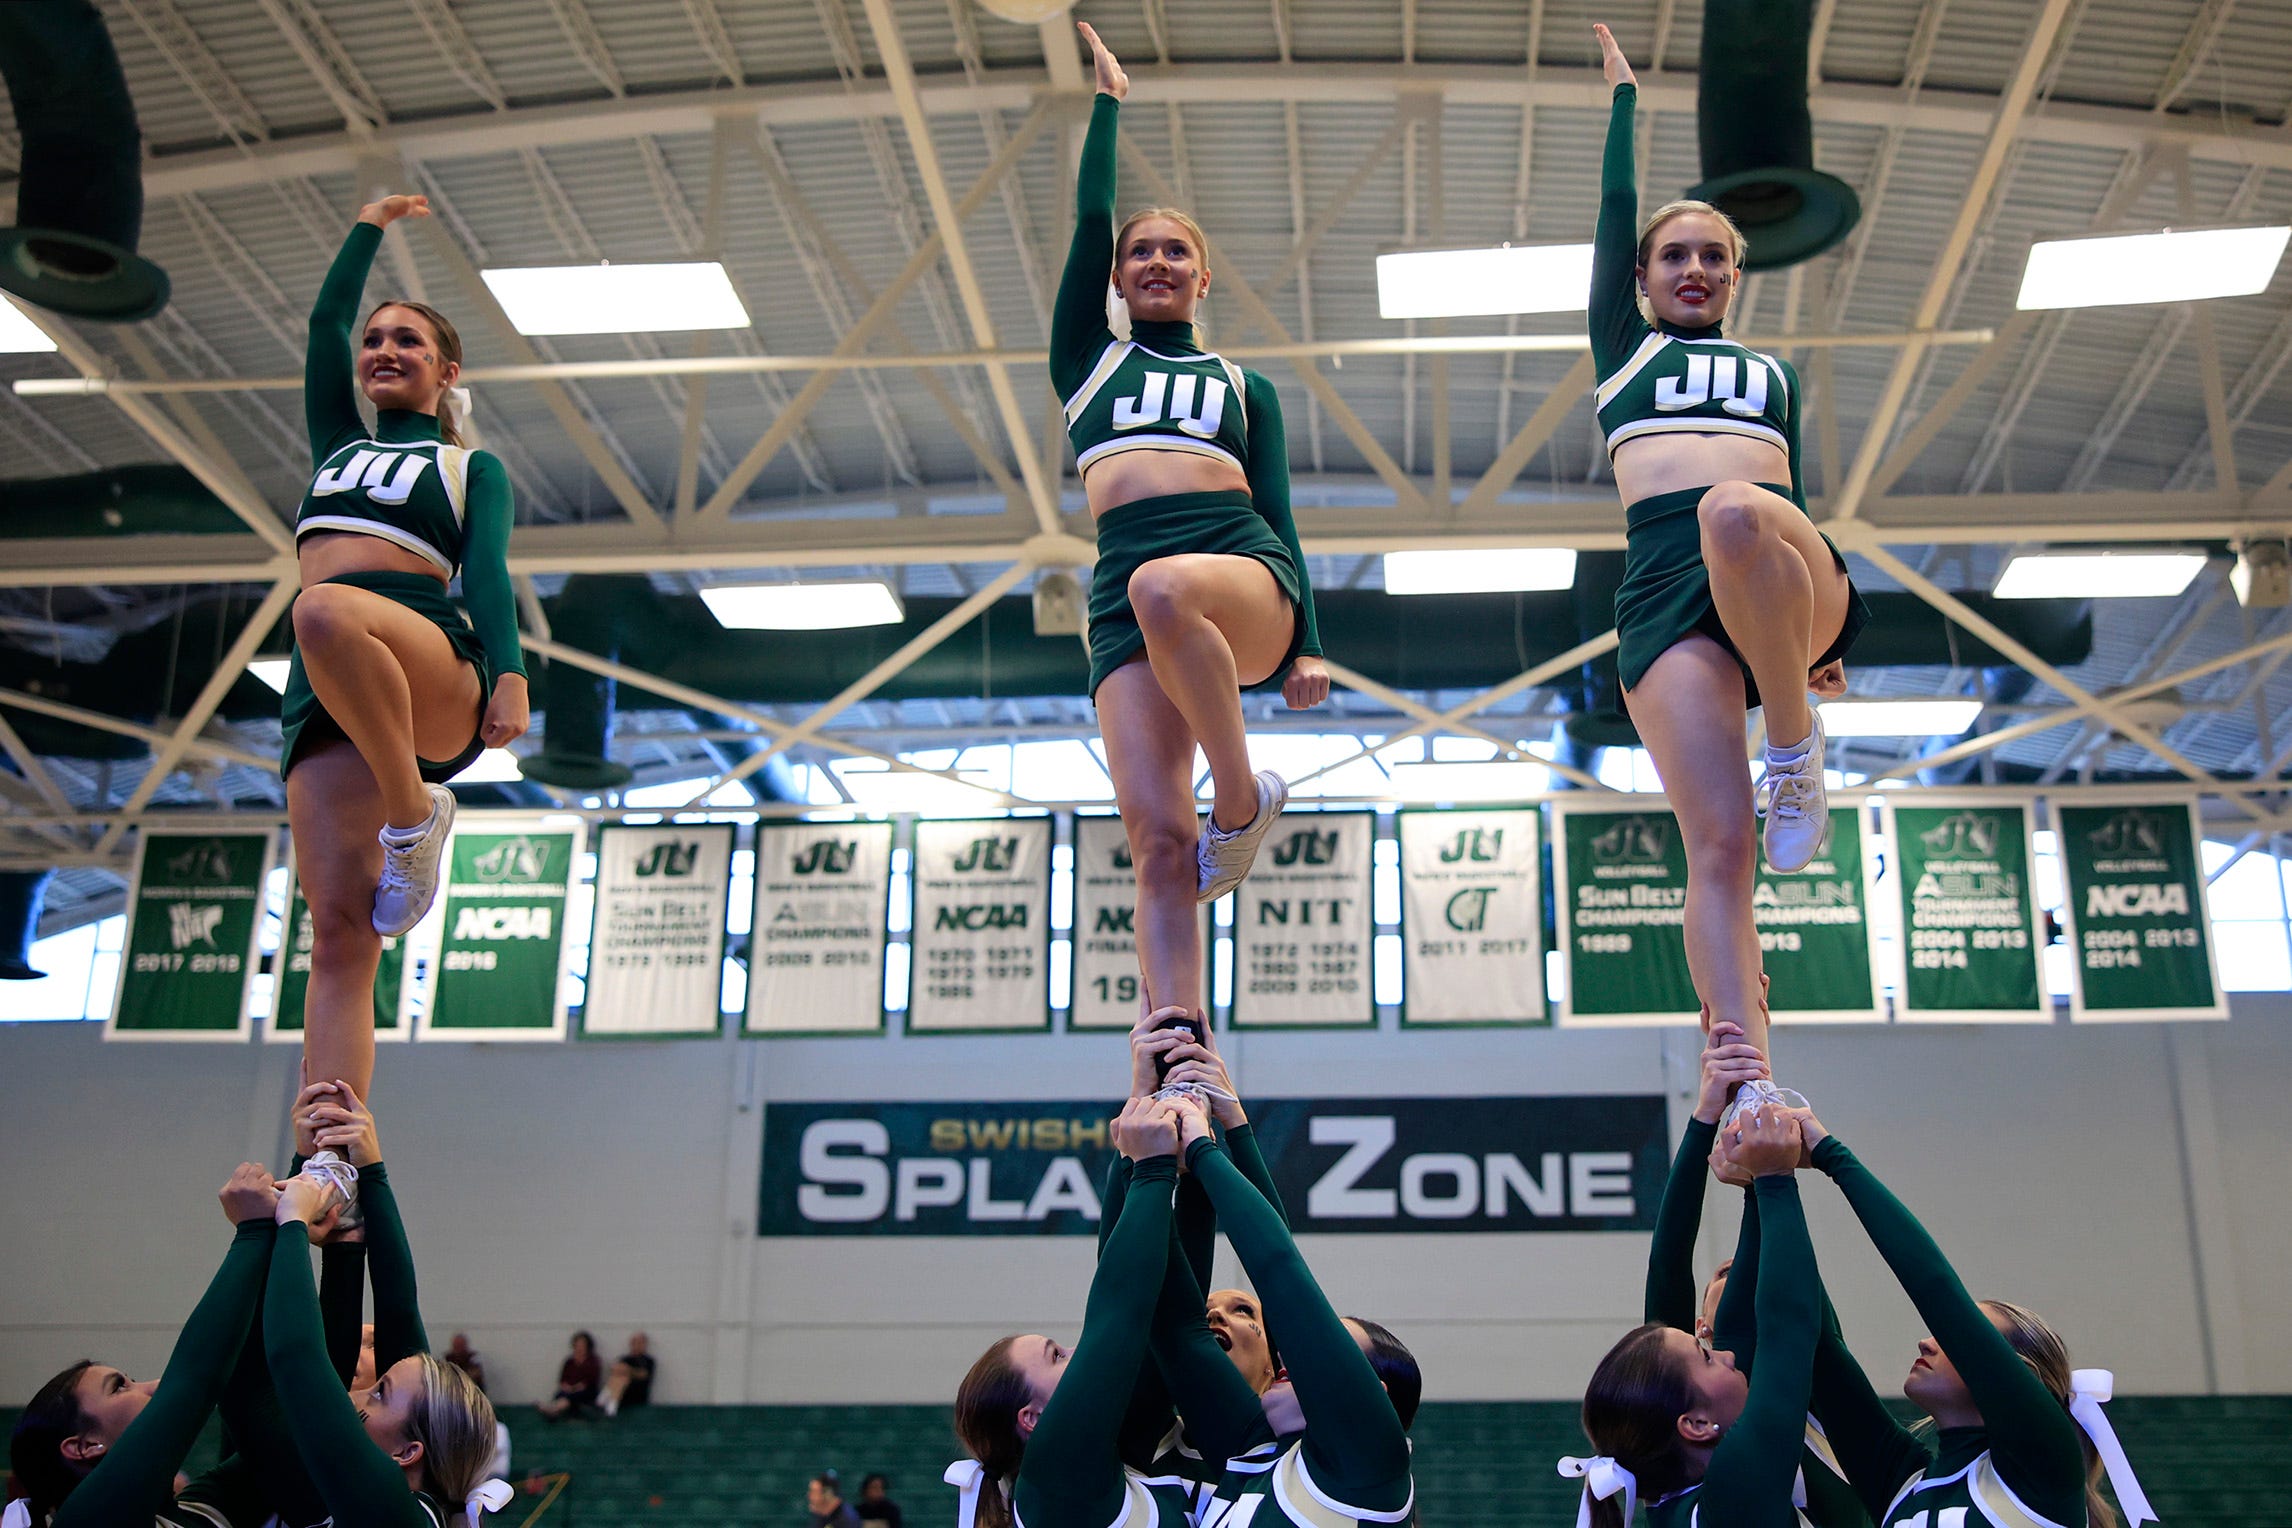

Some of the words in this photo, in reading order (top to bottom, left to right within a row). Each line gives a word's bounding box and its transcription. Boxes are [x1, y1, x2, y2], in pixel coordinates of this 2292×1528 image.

[1654, 353, 1768, 417] JU
[1112, 371, 1229, 439] JU
[312, 449, 433, 505] JU
[635, 839, 699, 877] JU
[792, 837, 857, 875] JU
[952, 838, 1019, 872] JU
[1272, 829, 1339, 866] JU
[1440, 828, 1503, 862] JU
[1753, 881, 1854, 906] ASUN
[1912, 873, 2020, 898] ASUN
[1258, 899, 1353, 925] NIT
[1912, 897, 2019, 911] TOURNAMENT
[2086, 883, 2190, 917] NCAA
[453, 907, 552, 939] NCAA
[934, 903, 1028, 932] NCAA
[1095, 906, 1135, 933] NC
[1575, 907, 1685, 927] CHAMPION
[1754, 906, 1862, 925] HAMPIONS
[1912, 911, 2022, 928] CHAMPIONS
[1759, 932, 1802, 952] 013
[1911, 930, 1966, 949] 2004
[1972, 930, 2027, 949] 2013
[2084, 930, 2138, 949] 2004
[2144, 928, 2199, 947] 2013
[134, 953, 184, 972] 2017
[1912, 950, 1968, 969] 2014
[2086, 950, 2142, 969] 2014
[1092, 976, 1136, 1002] 19
[930, 1118, 1109, 1150] SWISH
[797, 1119, 1101, 1222] SPLA
